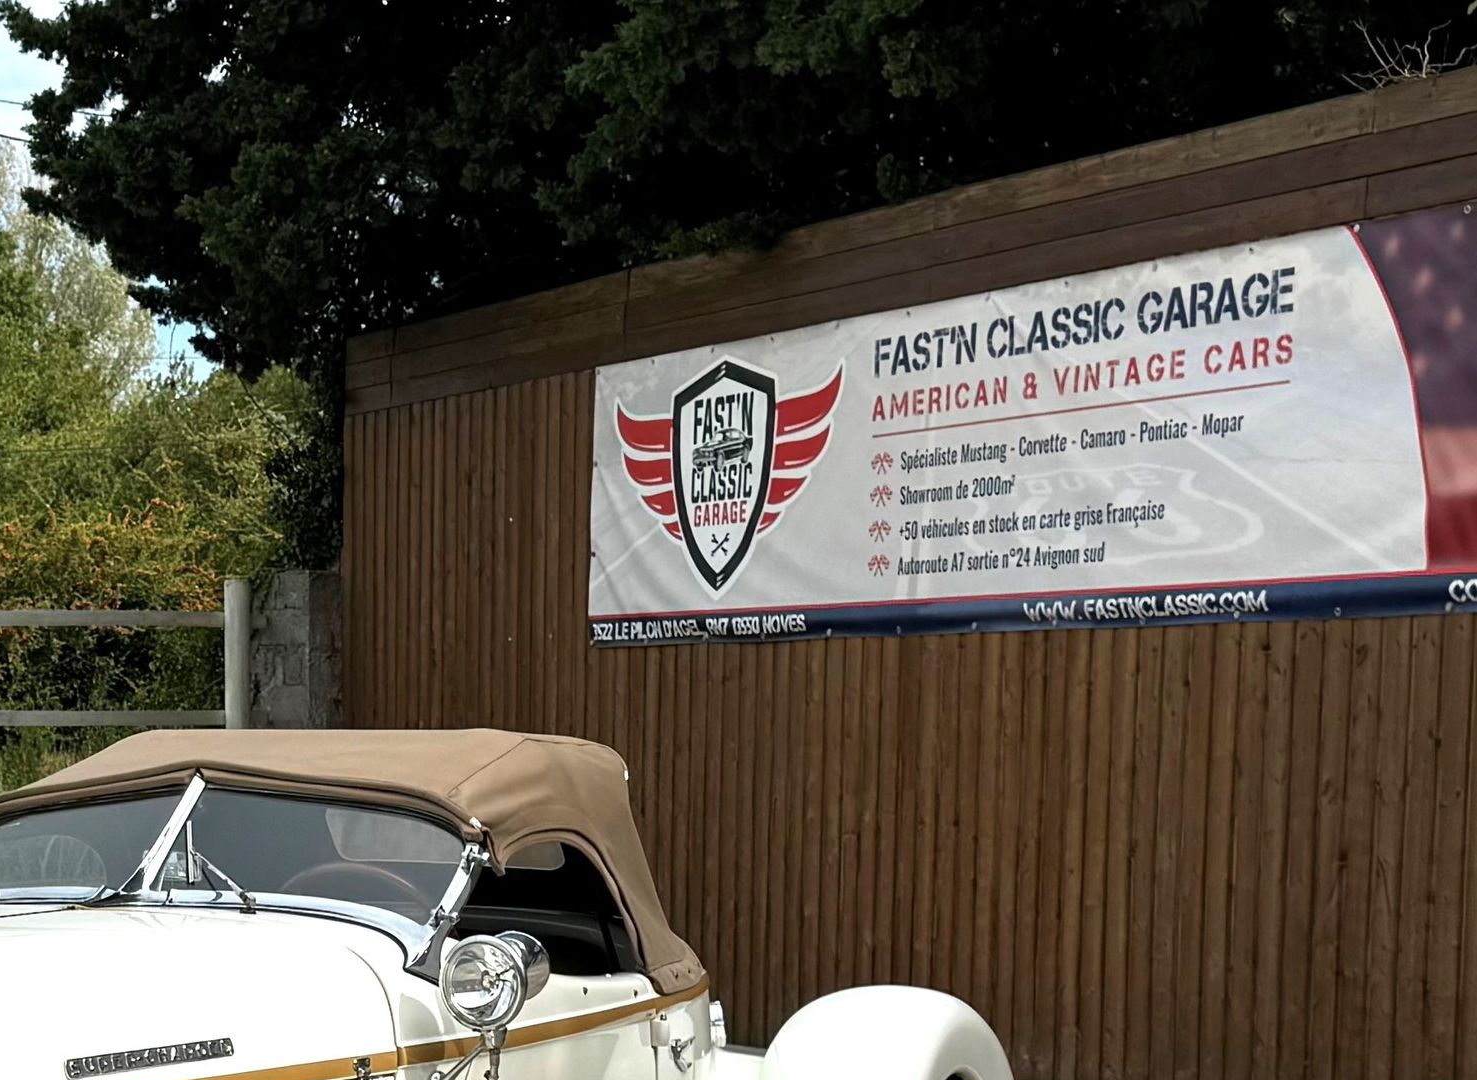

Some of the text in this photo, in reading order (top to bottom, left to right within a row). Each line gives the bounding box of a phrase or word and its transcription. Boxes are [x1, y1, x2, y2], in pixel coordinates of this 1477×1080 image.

[874, 266, 1295, 378] FAST'N CLASSIC GARAGE
[872, 334, 1294, 422] AMERICAN & VINTAGE CARS
[693, 391, 755, 445] FAST'N
[900, 447, 958, 474] Spécialiste
[960, 442, 1007, 463] Mustang
[1018, 433, 1067, 457] Corvette
[1080, 428, 1126, 450] Camaro
[1139, 418, 1188, 443] Pontiac
[1202, 413, 1245, 438] Mopar
[691, 462, 753, 504] CLASSIC
[900, 474, 1016, 506] Showroom de 2000m²
[693, 500, 748, 528] GARAGE
[899, 500, 1165, 541] +50 véhicules en stock en carte grise Française
[897, 541, 1106, 576] Autoroute A7 sortie n°24 Avignon sud
[615, 622, 629, 641] LE
[762, 613, 807, 634] NOVES
